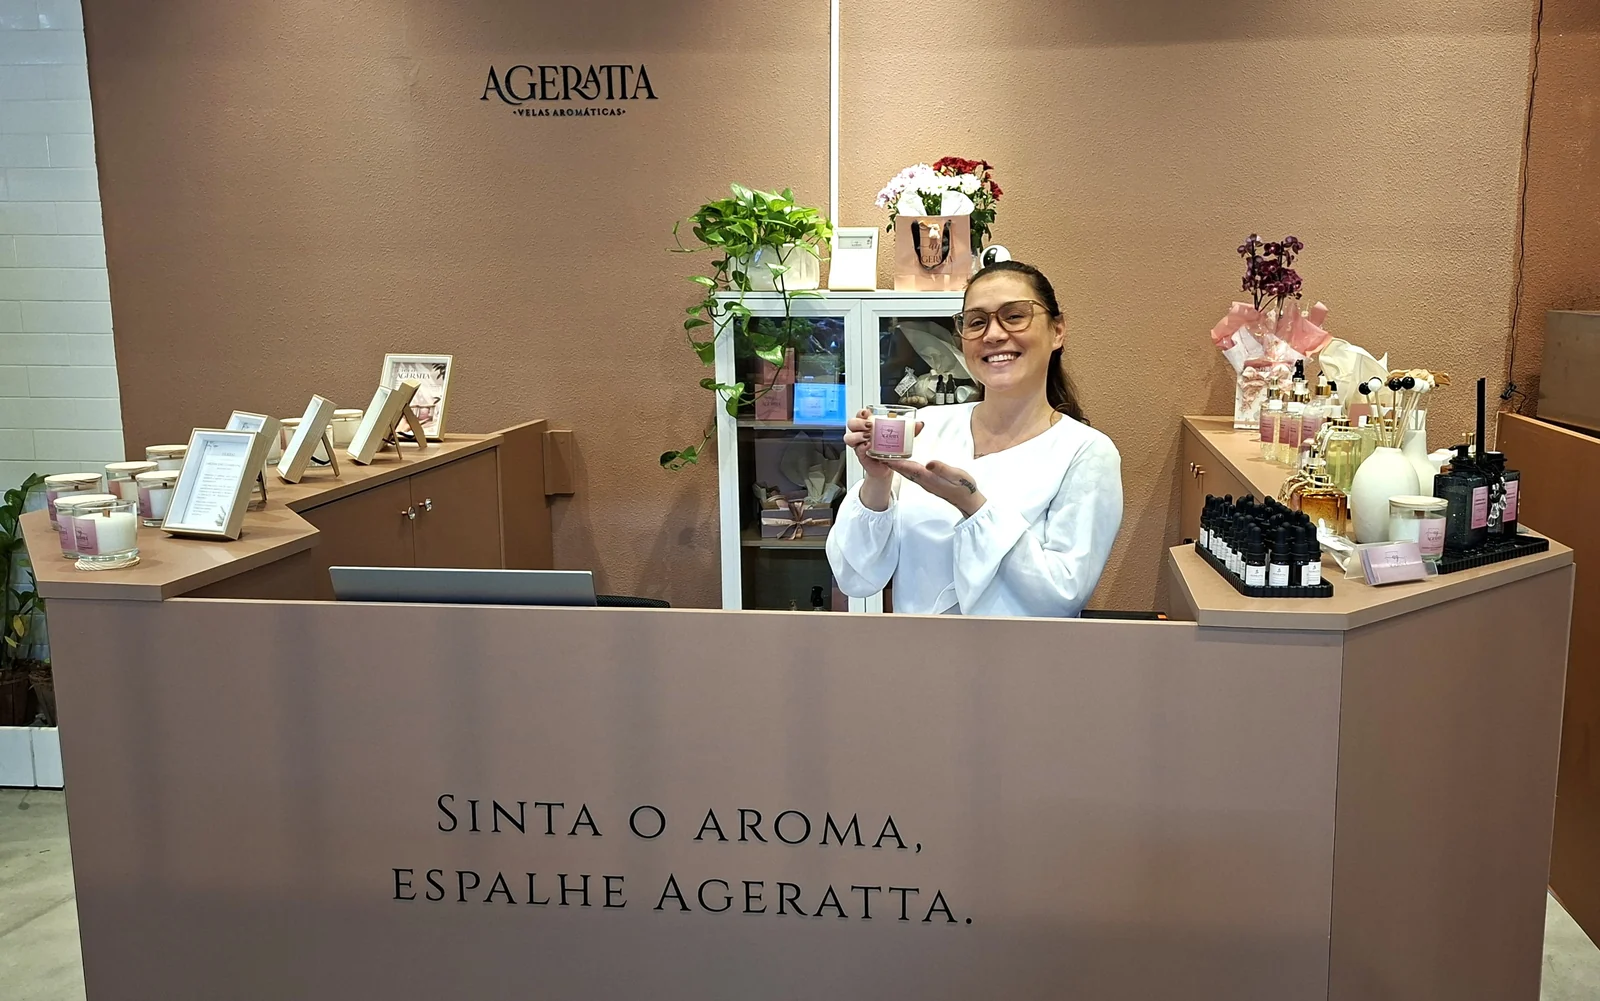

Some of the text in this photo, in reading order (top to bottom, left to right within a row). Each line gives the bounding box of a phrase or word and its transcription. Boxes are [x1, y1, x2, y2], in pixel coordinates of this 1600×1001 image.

[480, 64, 659, 106] AGERATTA
[437, 794, 922, 854] SINTA O AROMA,
[392, 868, 972, 924] ESPALHE AGERATTA.
